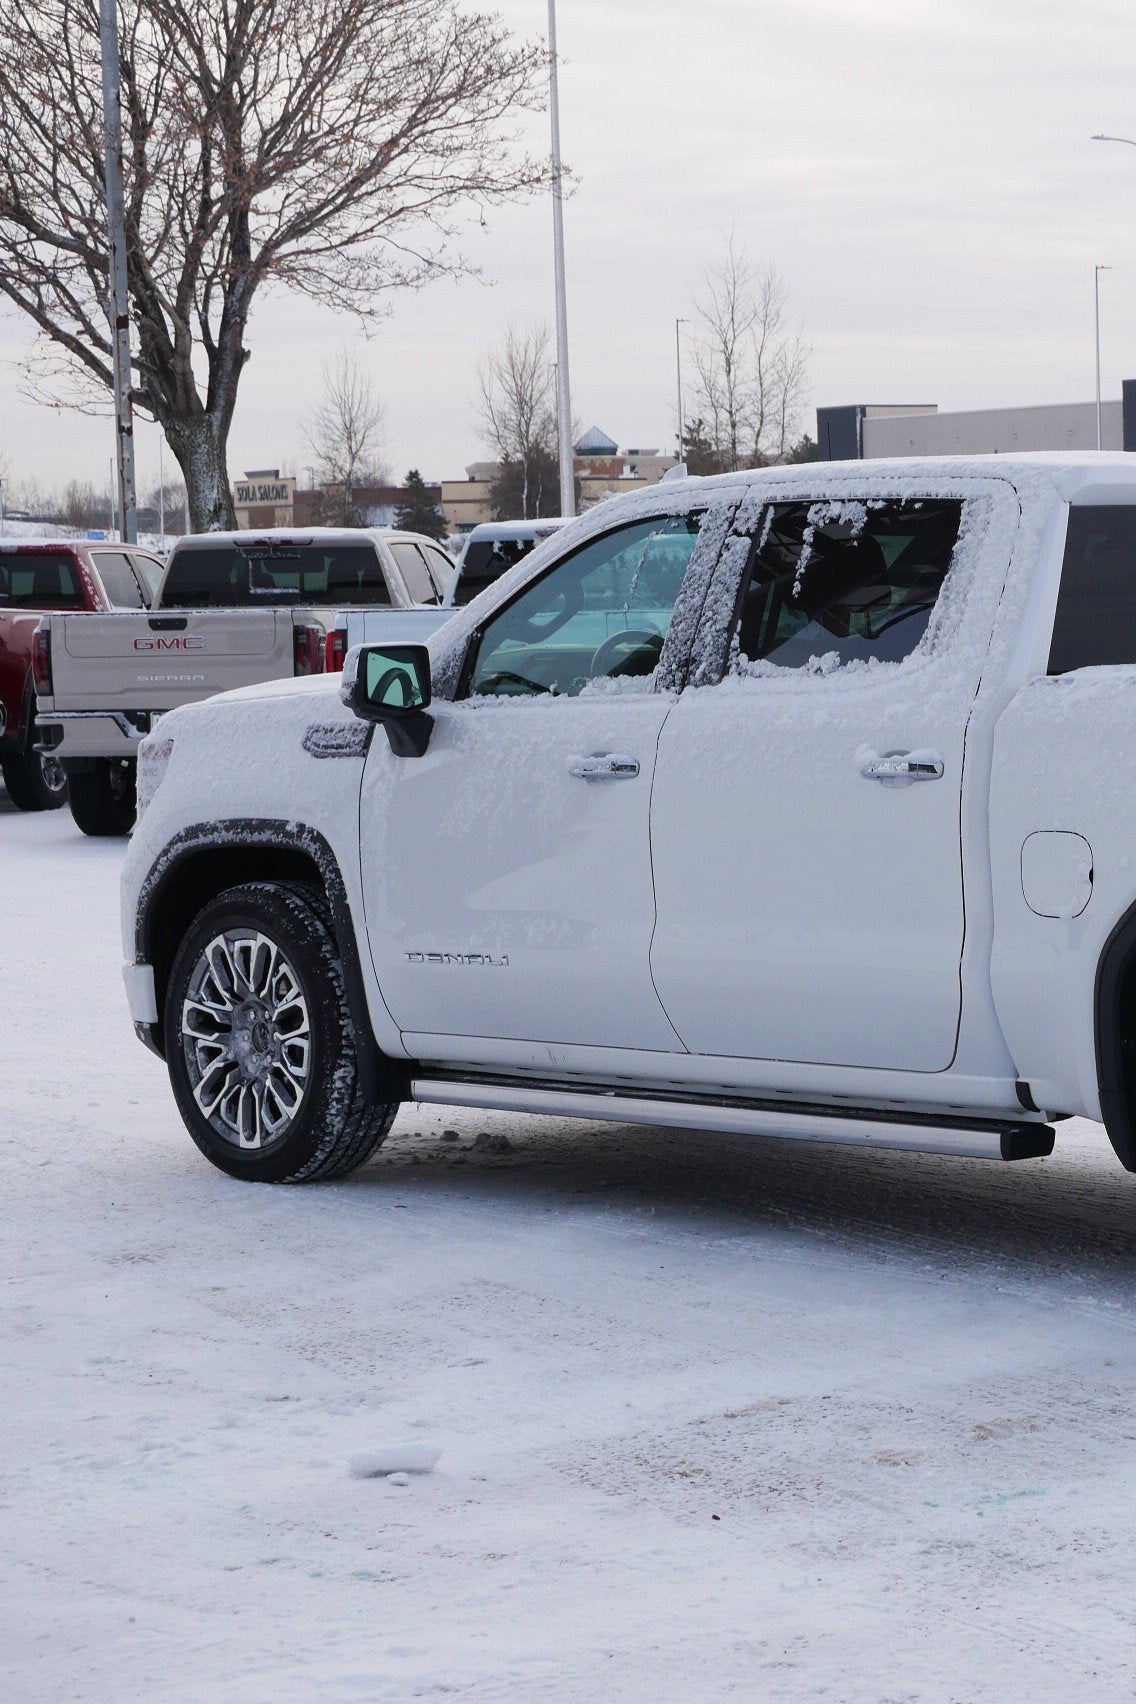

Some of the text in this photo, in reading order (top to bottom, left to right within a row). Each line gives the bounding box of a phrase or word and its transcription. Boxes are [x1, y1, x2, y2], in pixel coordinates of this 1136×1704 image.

[237, 483, 289, 502] SOLA SALONS
[133, 637, 205, 650] GMC
[404, 951, 509, 966] DENALI
